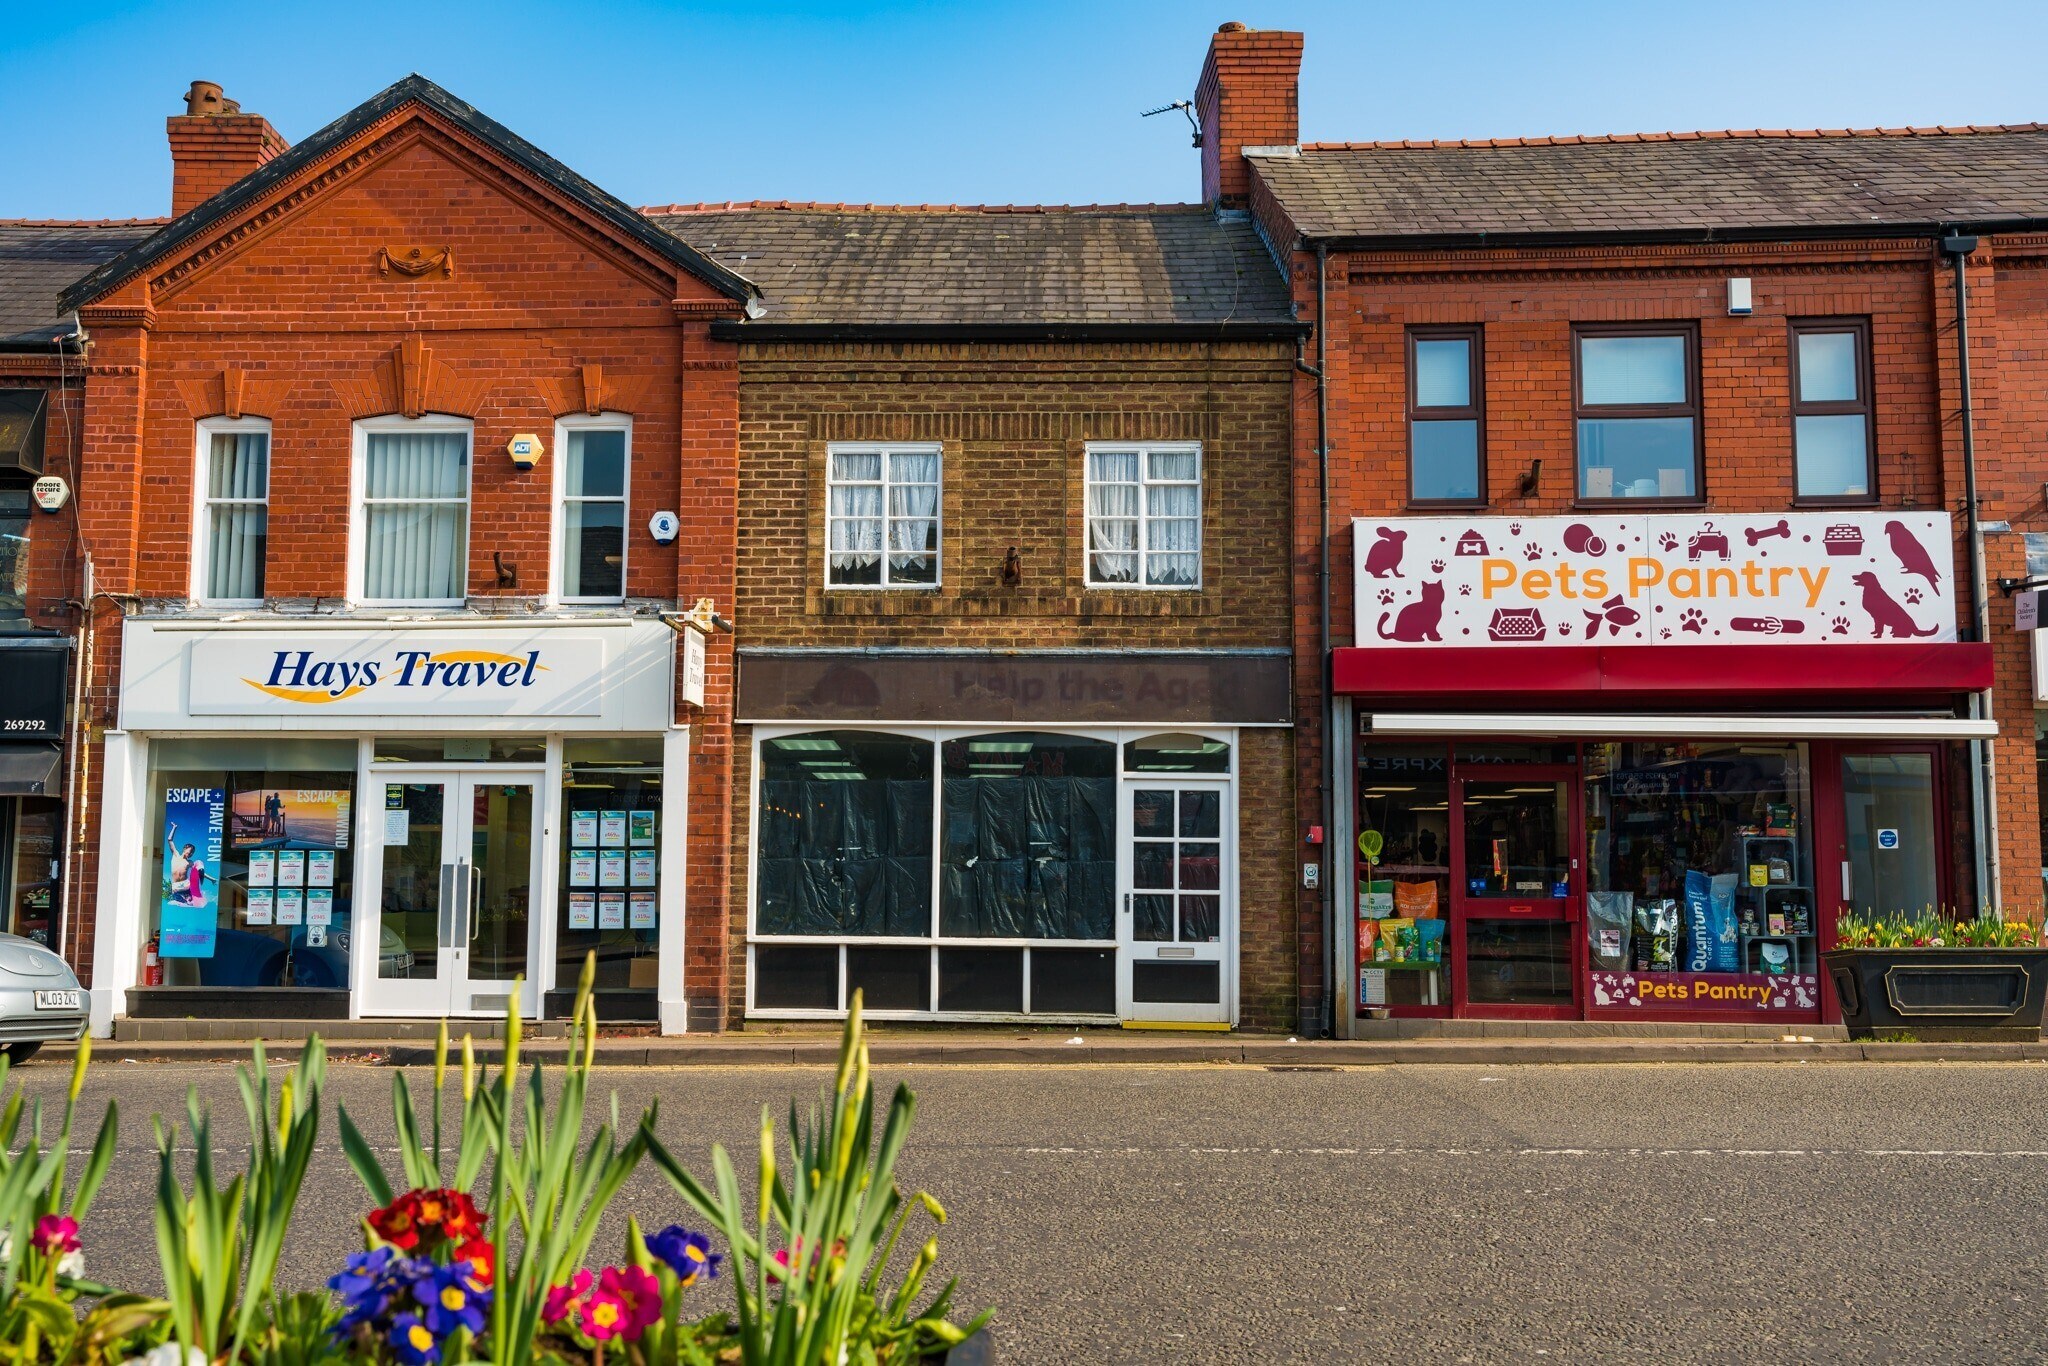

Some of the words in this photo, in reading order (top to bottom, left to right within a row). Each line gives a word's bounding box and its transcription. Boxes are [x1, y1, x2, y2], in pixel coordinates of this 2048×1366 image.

[514, 443, 531, 452] ADT
[1481, 558, 1608, 600] Pets
[1627, 556, 1831, 608] Pantry
[263, 651, 382, 697] Hays
[394, 650, 540, 688] Travel
[1058, 668, 1125, 702] the
[3, 719, 46, 731] 269292
[166, 788, 212, 803] ESCAPE
[296, 790, 339, 803] ESCAPE
[208, 802, 225, 834] HAVE
[335, 803, 350, 849] UNWIND
[206, 837, 223, 862] FUN
[1691, 901, 1707, 972] Quantum
[40, 992, 63, 1006] ML03
[64, 992, 77, 1006] ZKZ
[1638, 980, 1689, 999] Pets
[1694, 981, 1772, 1004] Pantry
